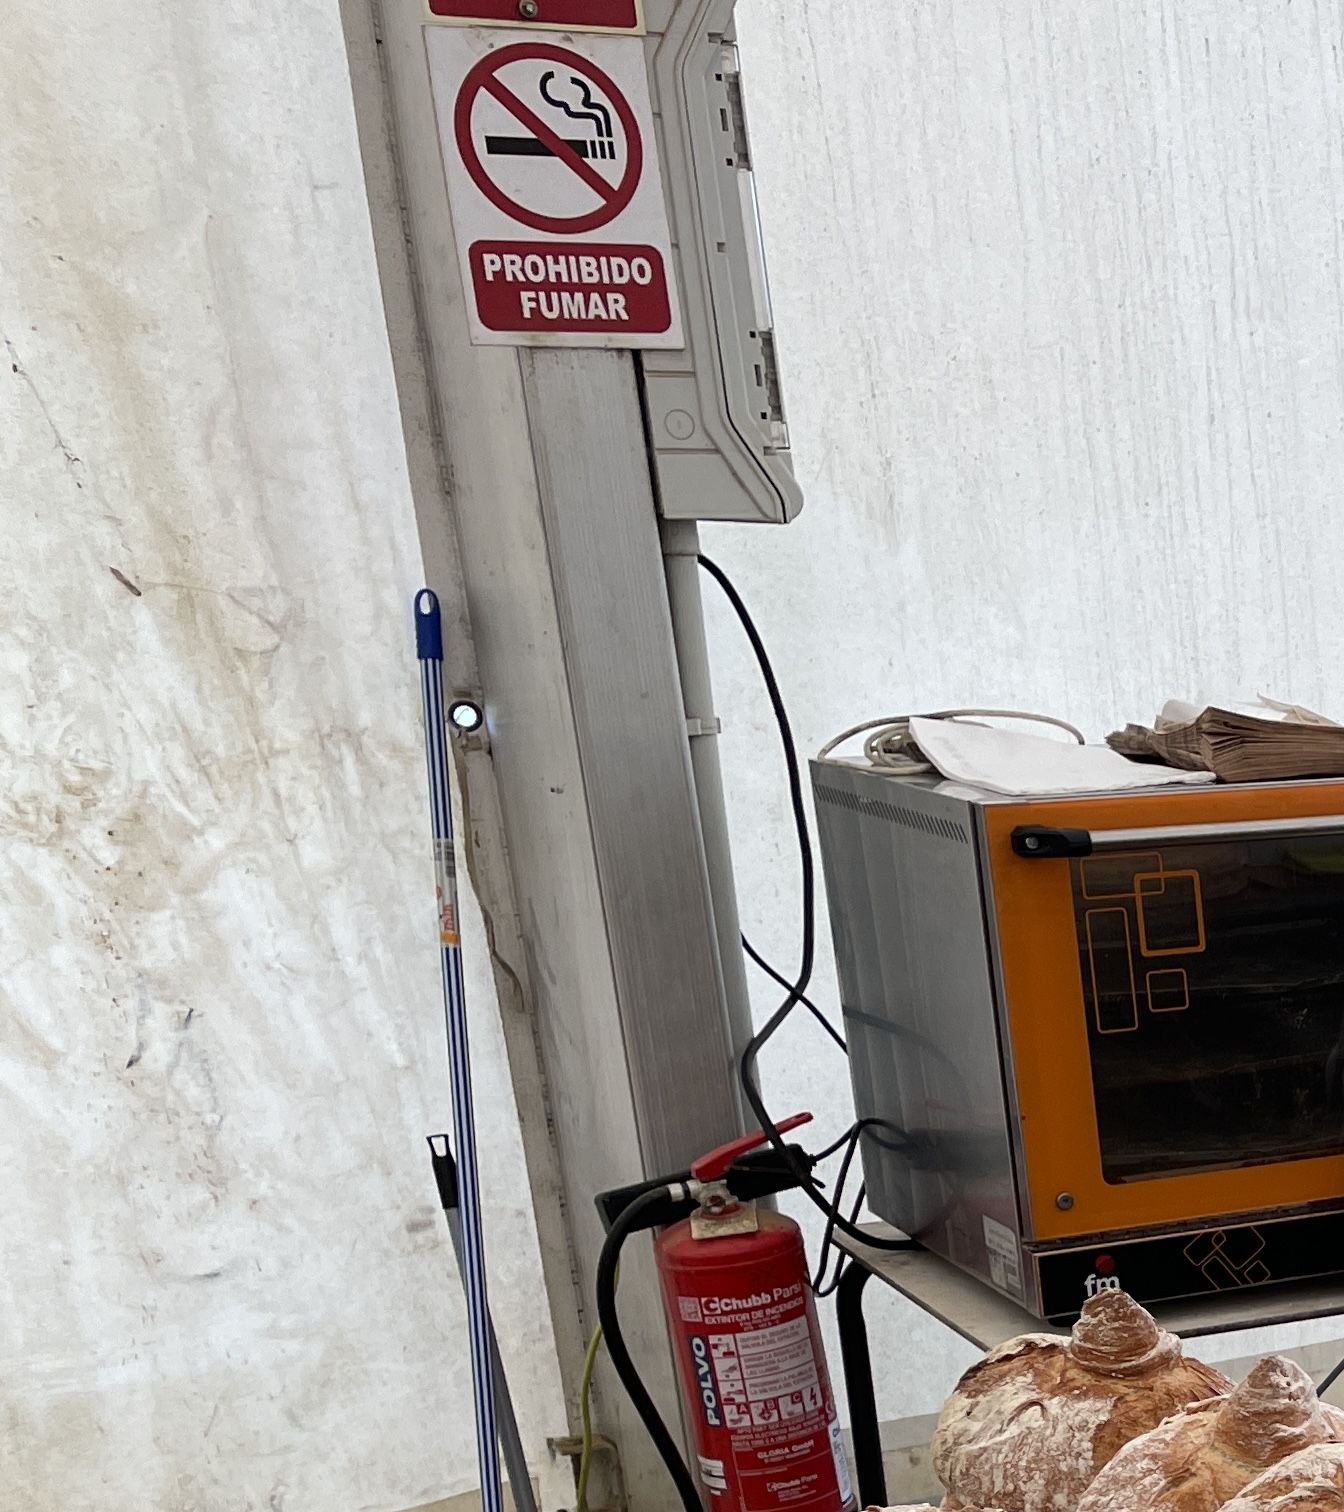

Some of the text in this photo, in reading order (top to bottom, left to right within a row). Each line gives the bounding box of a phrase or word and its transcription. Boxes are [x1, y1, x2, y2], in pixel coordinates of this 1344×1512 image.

[482, 253, 652, 285] PROHIBIDO
[520, 291, 629, 320] FUMAR
[720, 1292, 771, 1311] Chubb
[704, 1312, 750, 1325] EXTINTOR
[751, 1308, 765, 1320] DE
[692, 1336, 720, 1425] POLVO
